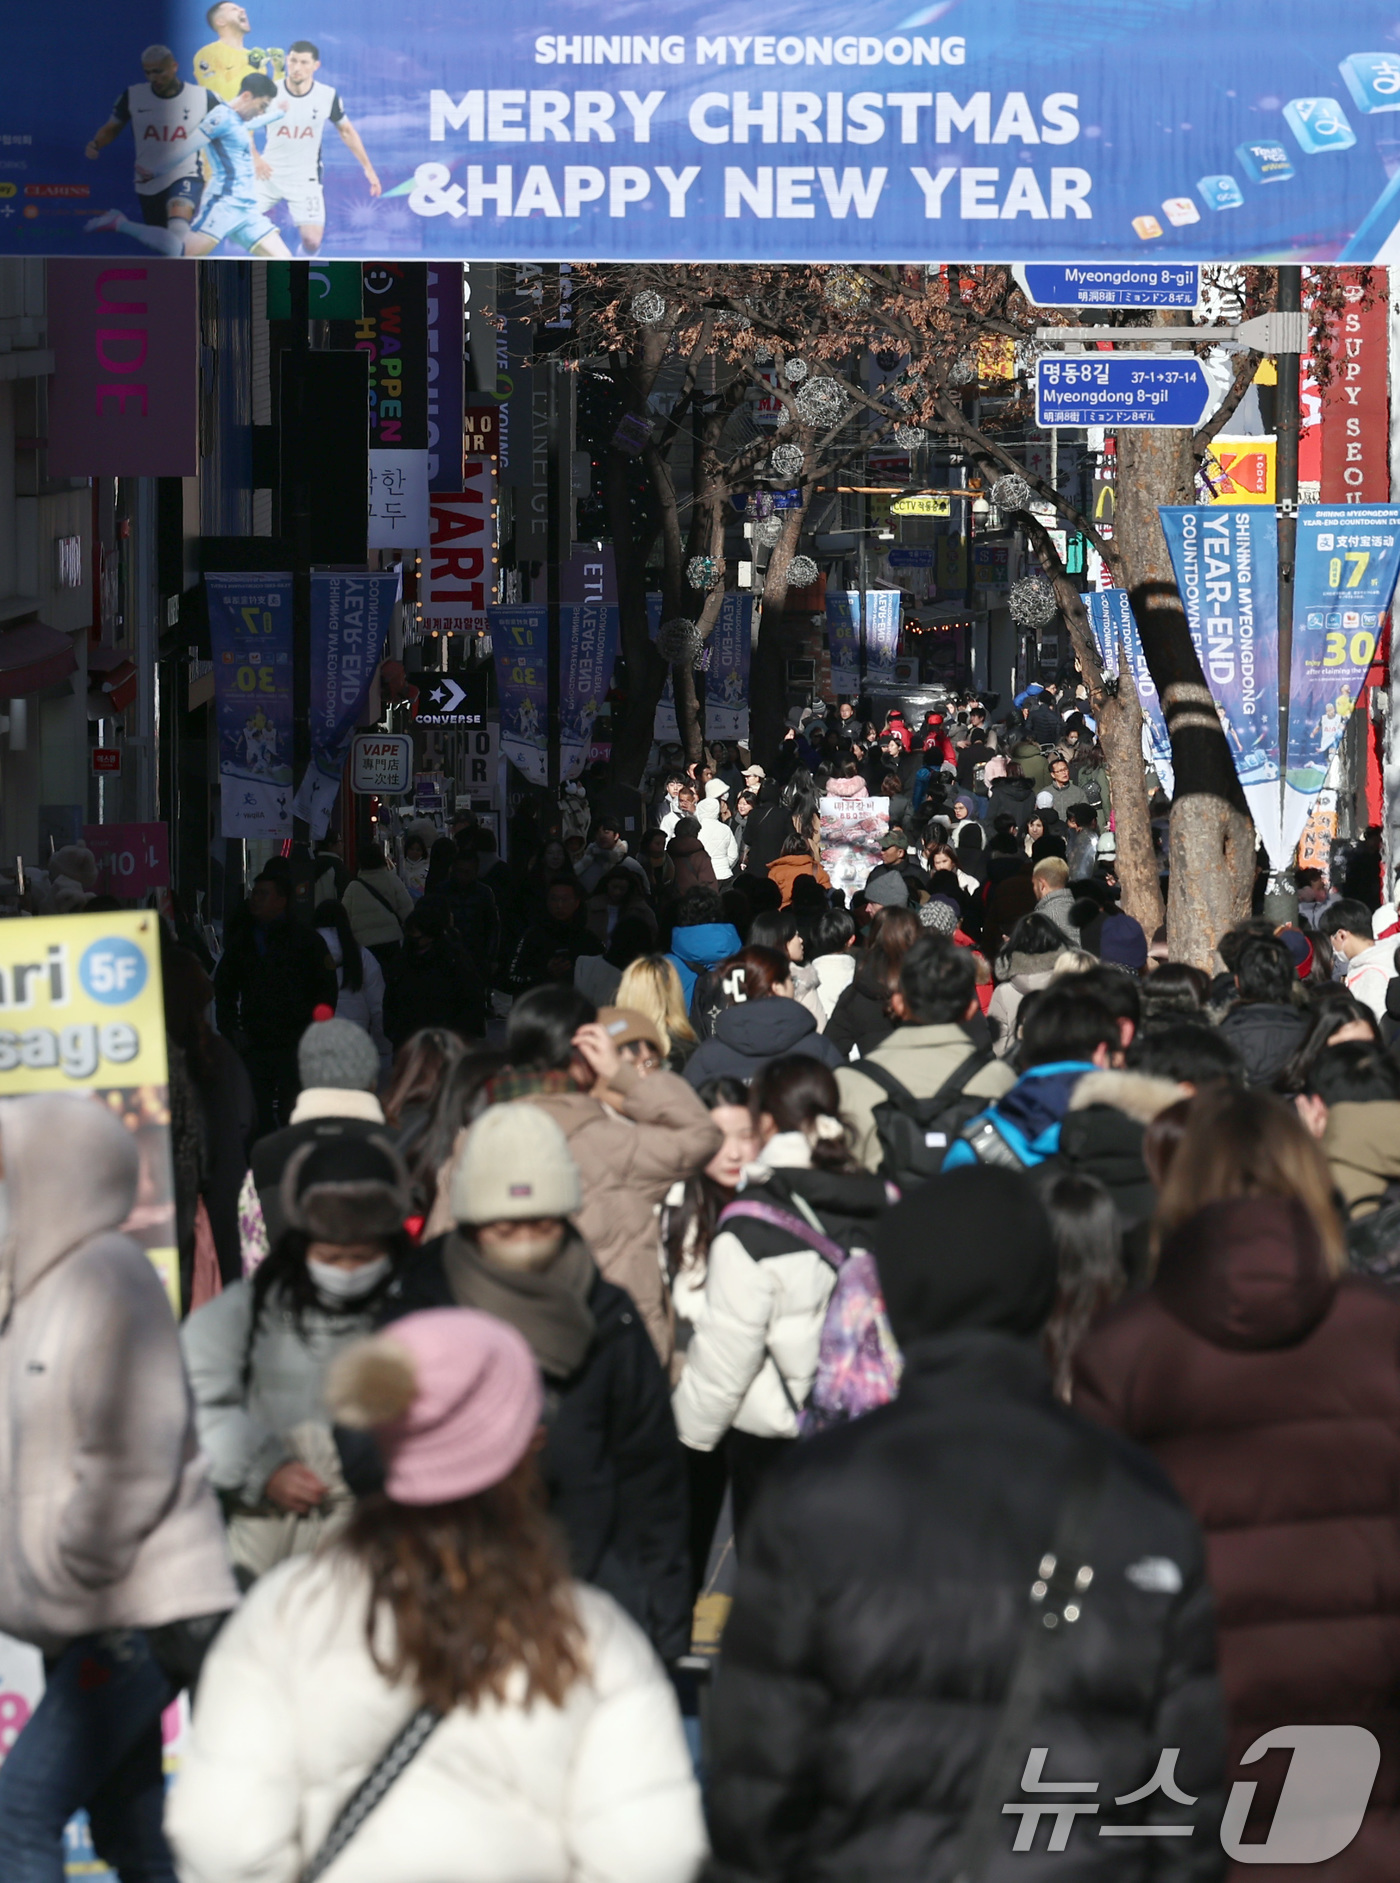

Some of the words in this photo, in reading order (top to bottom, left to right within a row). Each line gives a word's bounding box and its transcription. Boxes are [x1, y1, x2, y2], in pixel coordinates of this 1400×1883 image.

[534, 36, 685, 65] SHINING
[696, 36, 966, 65] MYEONGDONG
[430, 90, 667, 143] MERRY
[688, 92, 1079, 145] CHRISTMAS
[143, 124, 188, 142] AIA
[276, 125, 314, 140] AIA
[408, 162, 700, 219] &HAPPY
[724, 166, 887, 220] NEW
[910, 166, 1093, 220] YEAR
[1065, 268, 1158, 286] Myeongdong
[1161, 270, 1194, 287] 8-gil
[1345, 313, 1363, 405] SUPY
[379, 305, 403, 442] WAPPEN
[1043, 363, 1110, 385] 명동8길
[1043, 389, 1134, 405] Myeongdong
[1137, 389, 1169, 405] 8-gil
[949, 455, 964, 465] 2F
[1256, 455, 1265, 491] KODAK
[893, 501, 917, 511] CCTV
[1315, 510, 1345, 518] SHINING
[1303, 519, 1339, 527] YEAR-END
[1235, 513, 1251, 584] SHINING
[1336, 535, 1394, 548] 支付宝活动
[1181, 514, 1200, 628] COUNTDOWN
[1345, 551, 1370, 588] 7
[1203, 514, 1235, 685] YEAR-END
[1119, 592, 1134, 662] COUNTDOWN
[1238, 588, 1256, 715] MYEONGDONG
[1323, 631, 1375, 666] 30
[1321, 667, 1350, 675] claiming
[415, 715, 481, 724] CONVERSE
[363, 744, 400, 756] VAPE
[362, 758, 400, 771] 專門店
[361, 773, 400, 785] 一次性
[90, 952, 138, 993] 5F
